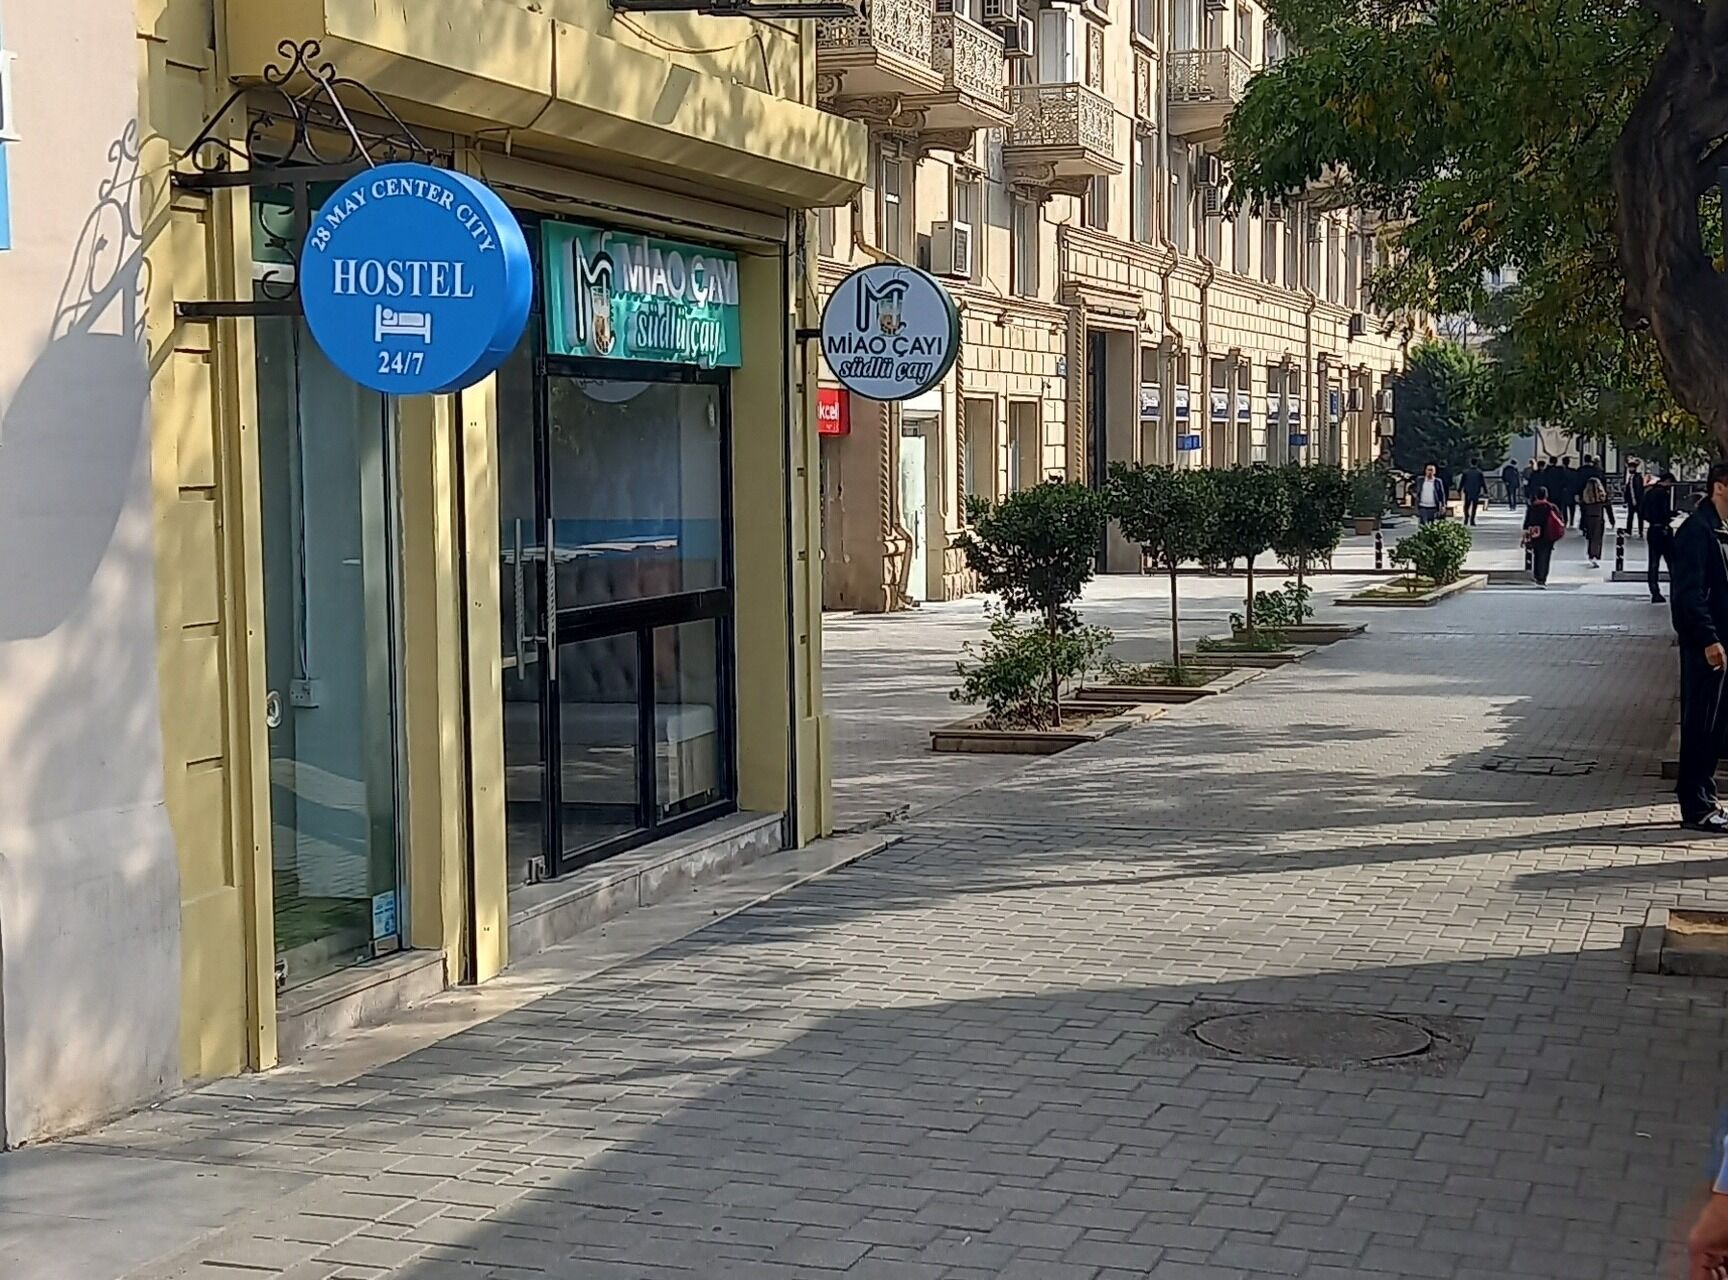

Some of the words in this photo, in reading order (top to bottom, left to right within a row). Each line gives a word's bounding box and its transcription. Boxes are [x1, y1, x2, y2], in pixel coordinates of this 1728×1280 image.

[311, 227, 331, 252] 28
[326, 188, 366, 230] MAY
[371, 178, 455, 211] CENTER
[456, 203, 497, 253] CITY
[332, 258, 474, 298] HOSTEL
[689, 316, 722, 369] çay
[828, 333, 886, 354] MİAO
[892, 336, 943, 358] ÇAYI
[377, 351, 424, 375] 24/7
[839, 356, 893, 378] südlü
[894, 361, 933, 385] çay
